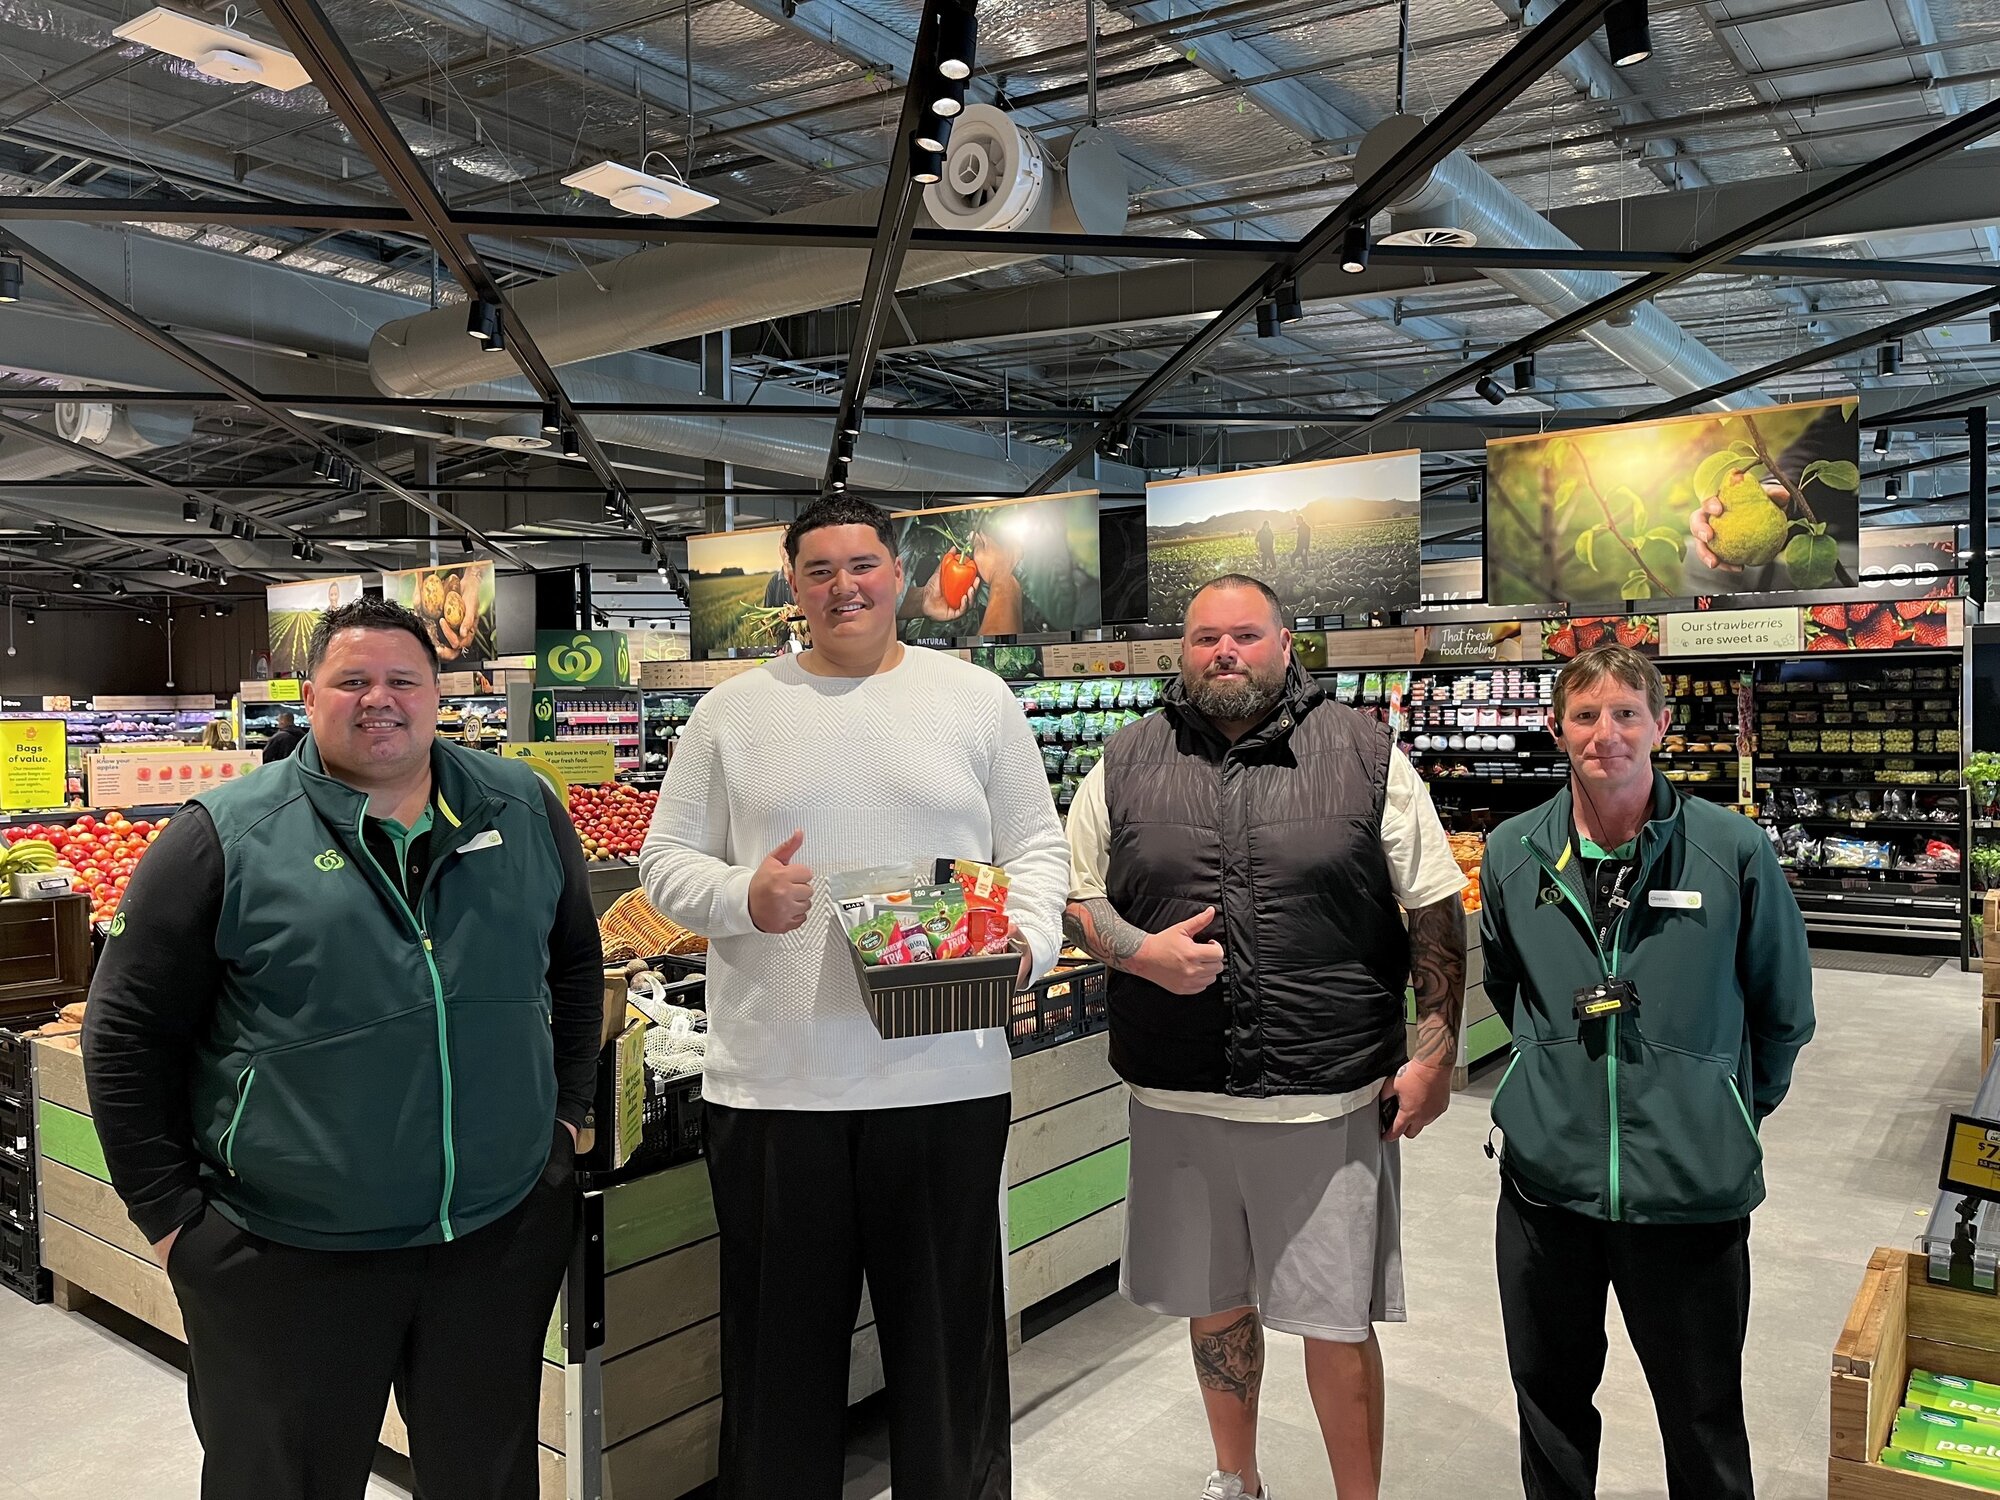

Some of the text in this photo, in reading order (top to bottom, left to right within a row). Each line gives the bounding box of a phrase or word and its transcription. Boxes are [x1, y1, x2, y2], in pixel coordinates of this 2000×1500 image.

[1681, 618, 1783, 632] Our strawberries
[1442, 627, 1493, 642] That fresh
[1695, 634, 1769, 645] are sweet as
[917, 638, 947, 646] NATURAL
[1440, 642, 1497, 660] food feeling
[16, 744, 43, 754] Bags
[8, 755, 51, 763] of value.
[914, 890, 926, 898] $50
[948, 933, 968, 950] TRIO
